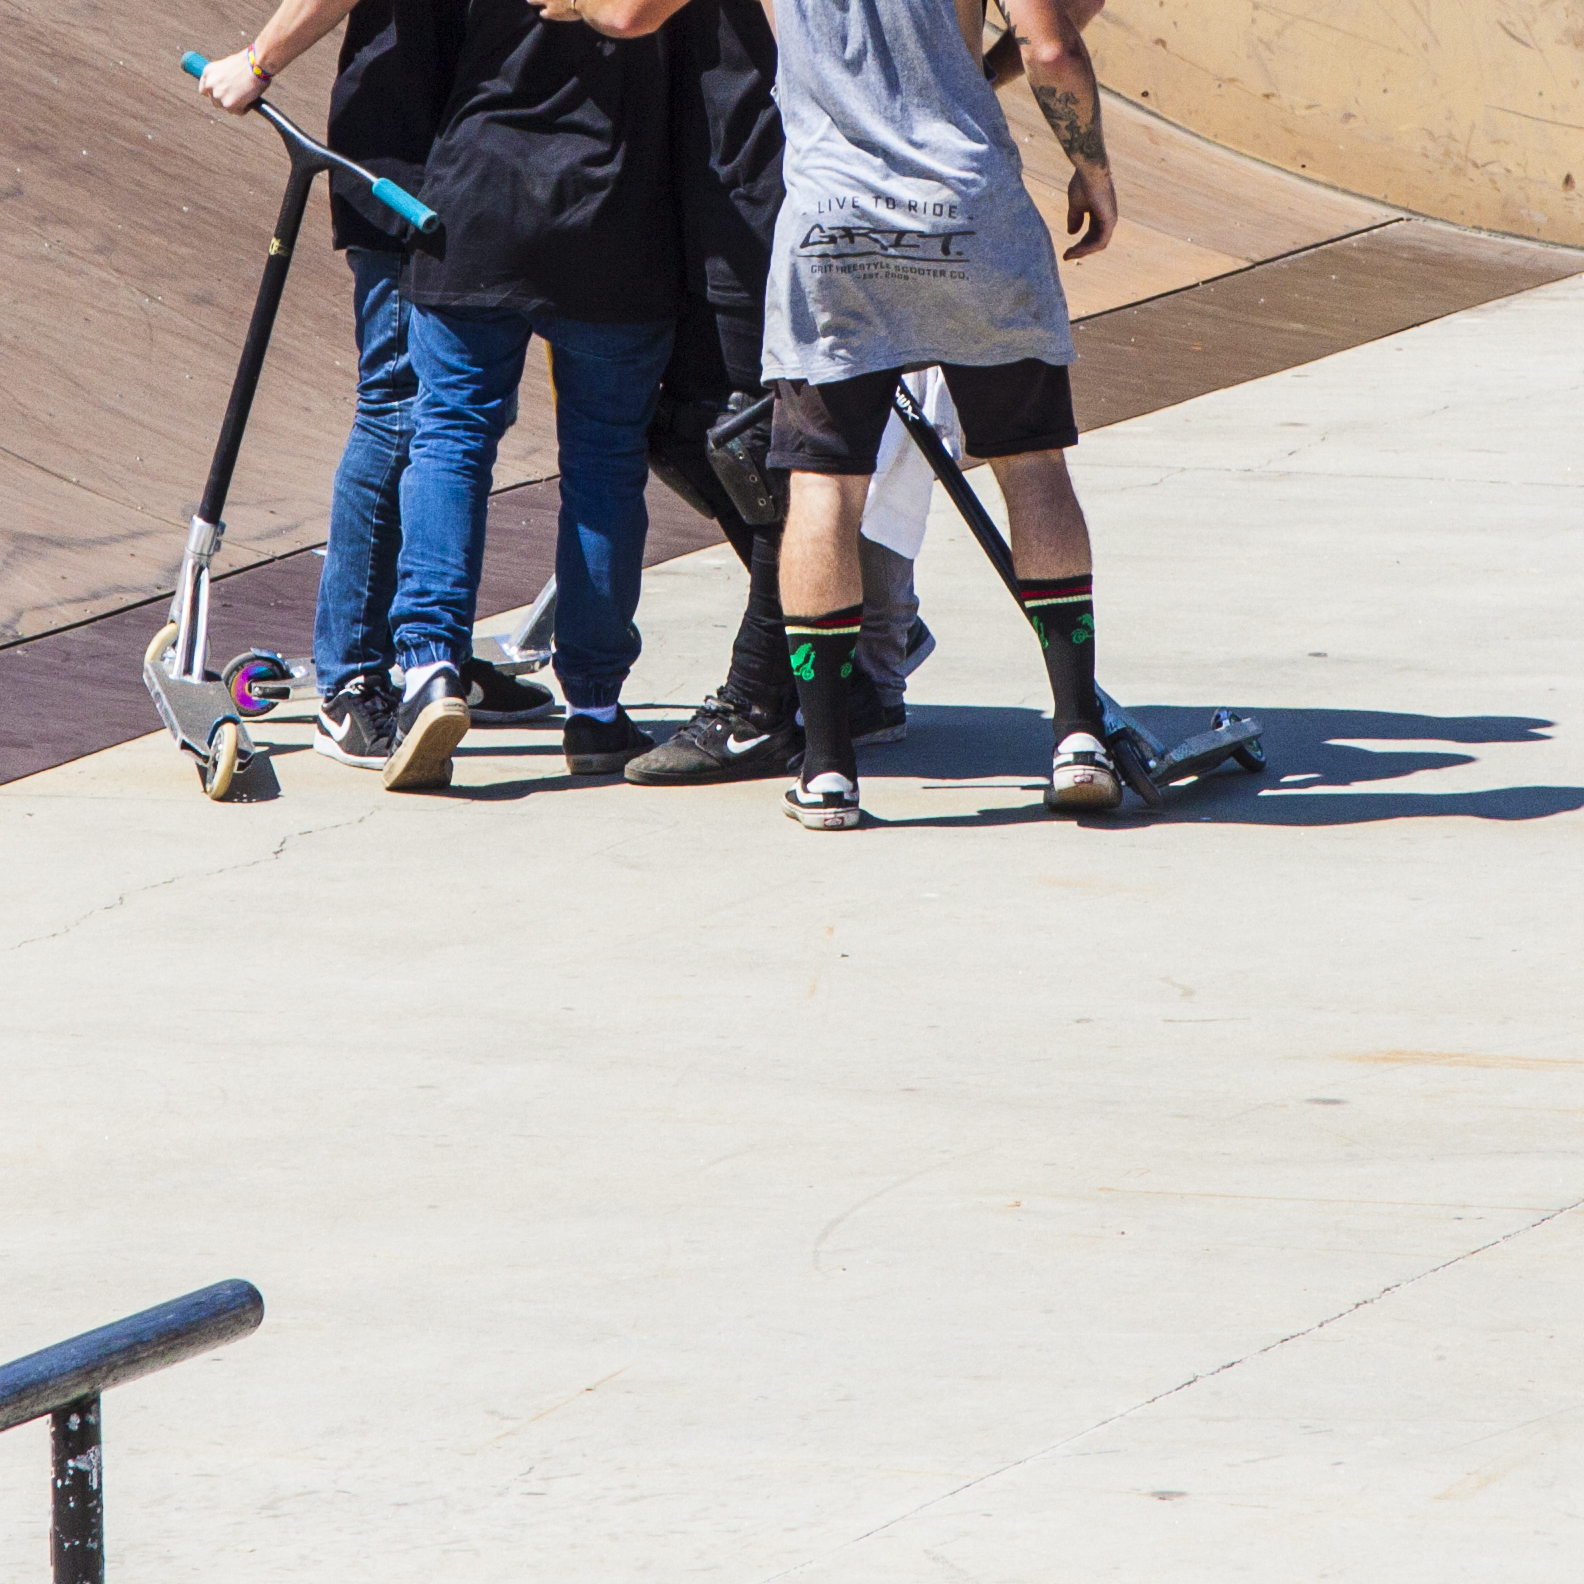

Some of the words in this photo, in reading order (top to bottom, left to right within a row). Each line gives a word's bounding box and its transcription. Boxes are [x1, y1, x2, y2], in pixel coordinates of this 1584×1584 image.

[817, 196, 860, 214] LIVE
[872, 196, 896, 209] TO
[908, 200, 958, 219] RIDE
[811, 263, 834, 274] GRIT
[894, 264, 947, 279] SCOOTER
